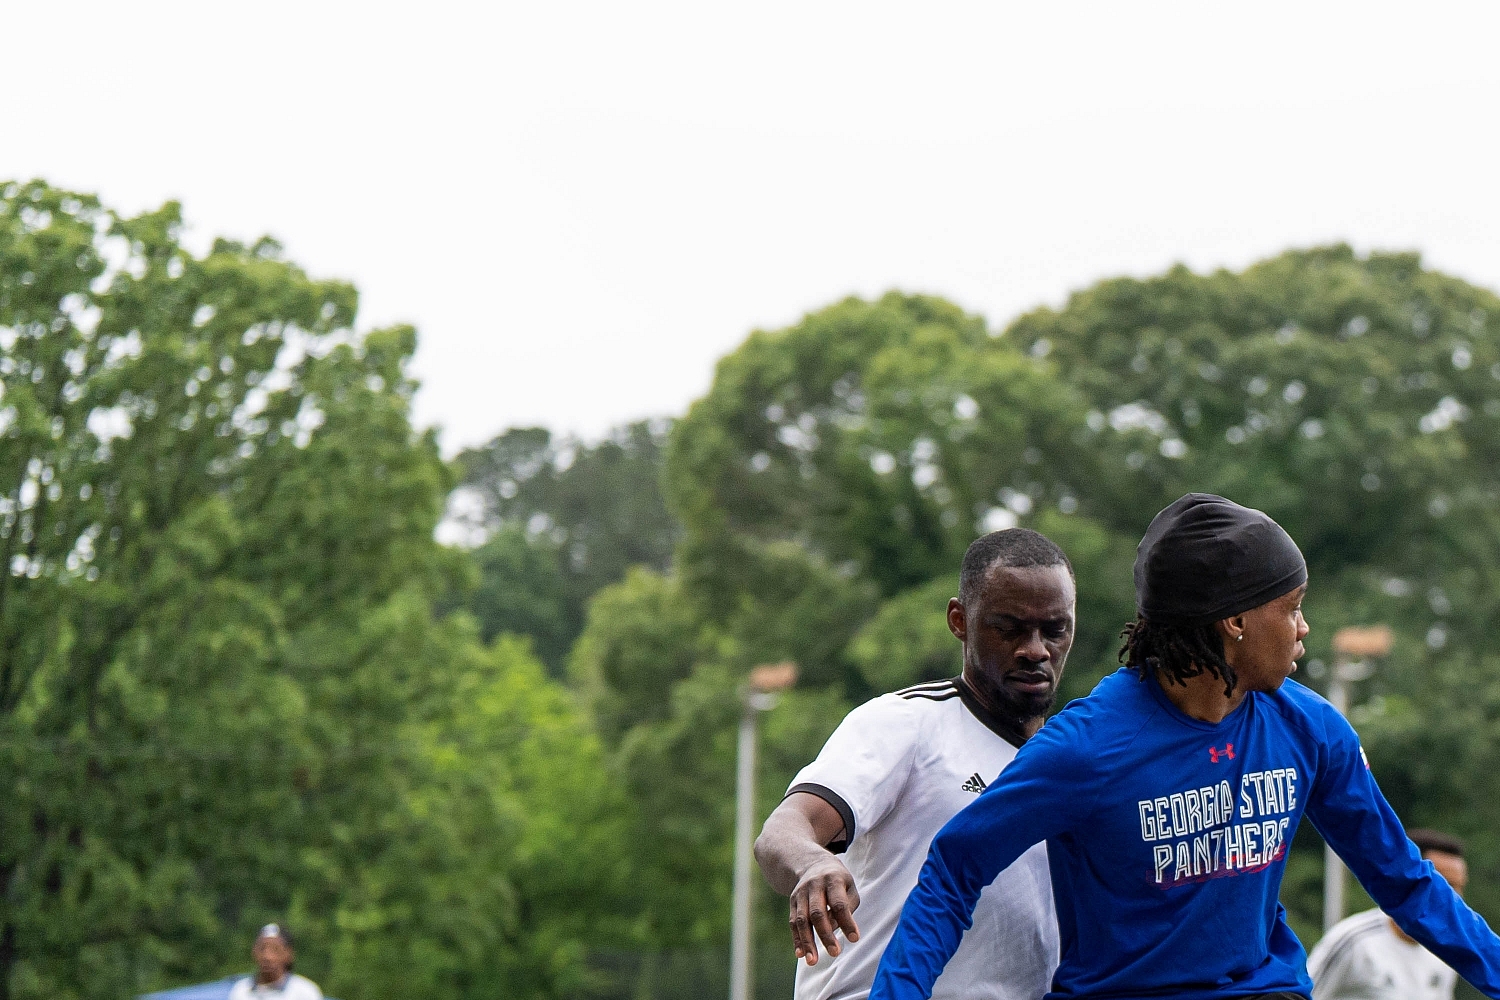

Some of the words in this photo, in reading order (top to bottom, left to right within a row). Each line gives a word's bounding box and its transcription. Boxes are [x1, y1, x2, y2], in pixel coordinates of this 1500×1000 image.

[961, 784, 983, 794] adid
[1138, 779, 1234, 842] GEORGIA
[1239, 767, 1298, 819] STATE
[1153, 816, 1290, 884] PANTHERS
